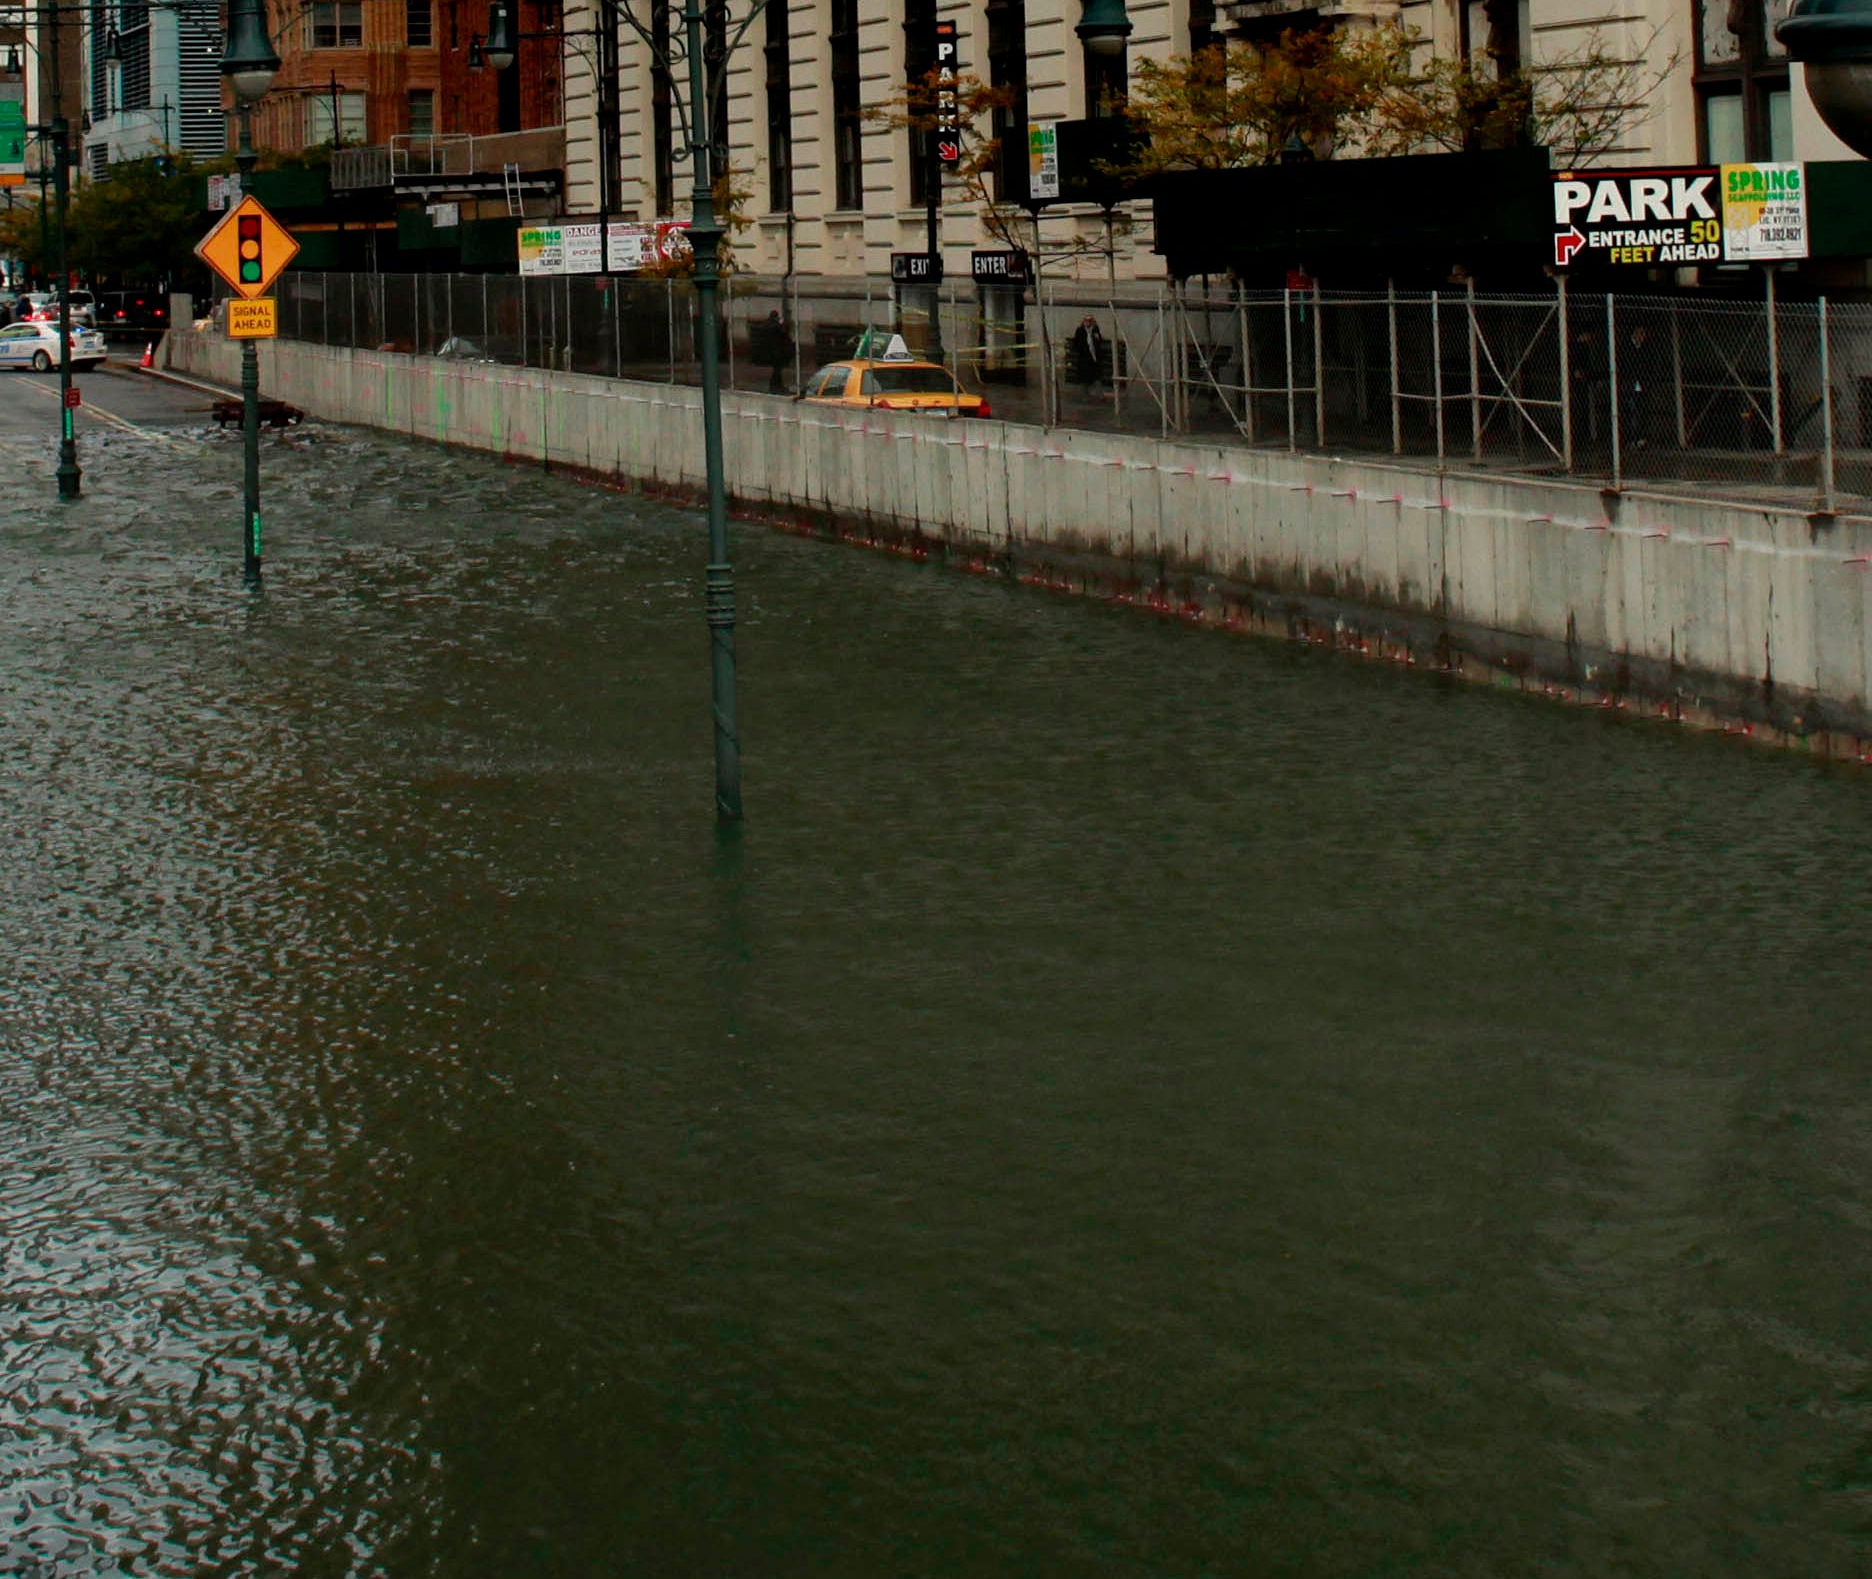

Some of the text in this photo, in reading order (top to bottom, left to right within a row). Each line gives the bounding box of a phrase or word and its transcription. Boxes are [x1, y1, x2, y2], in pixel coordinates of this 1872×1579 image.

[1727, 169, 1801, 192] SPRING
[1553, 176, 1717, 224] PARK
[566, 226, 602, 238] DANGE
[1588, 219, 1721, 248] ENTRANCE 50
[1610, 243, 1721, 264] FEET AHEAD
[974, 256, 1007, 274] ENTER
[233, 306, 271, 317] SIGNAL
[233, 319, 272, 330] AHEAD
